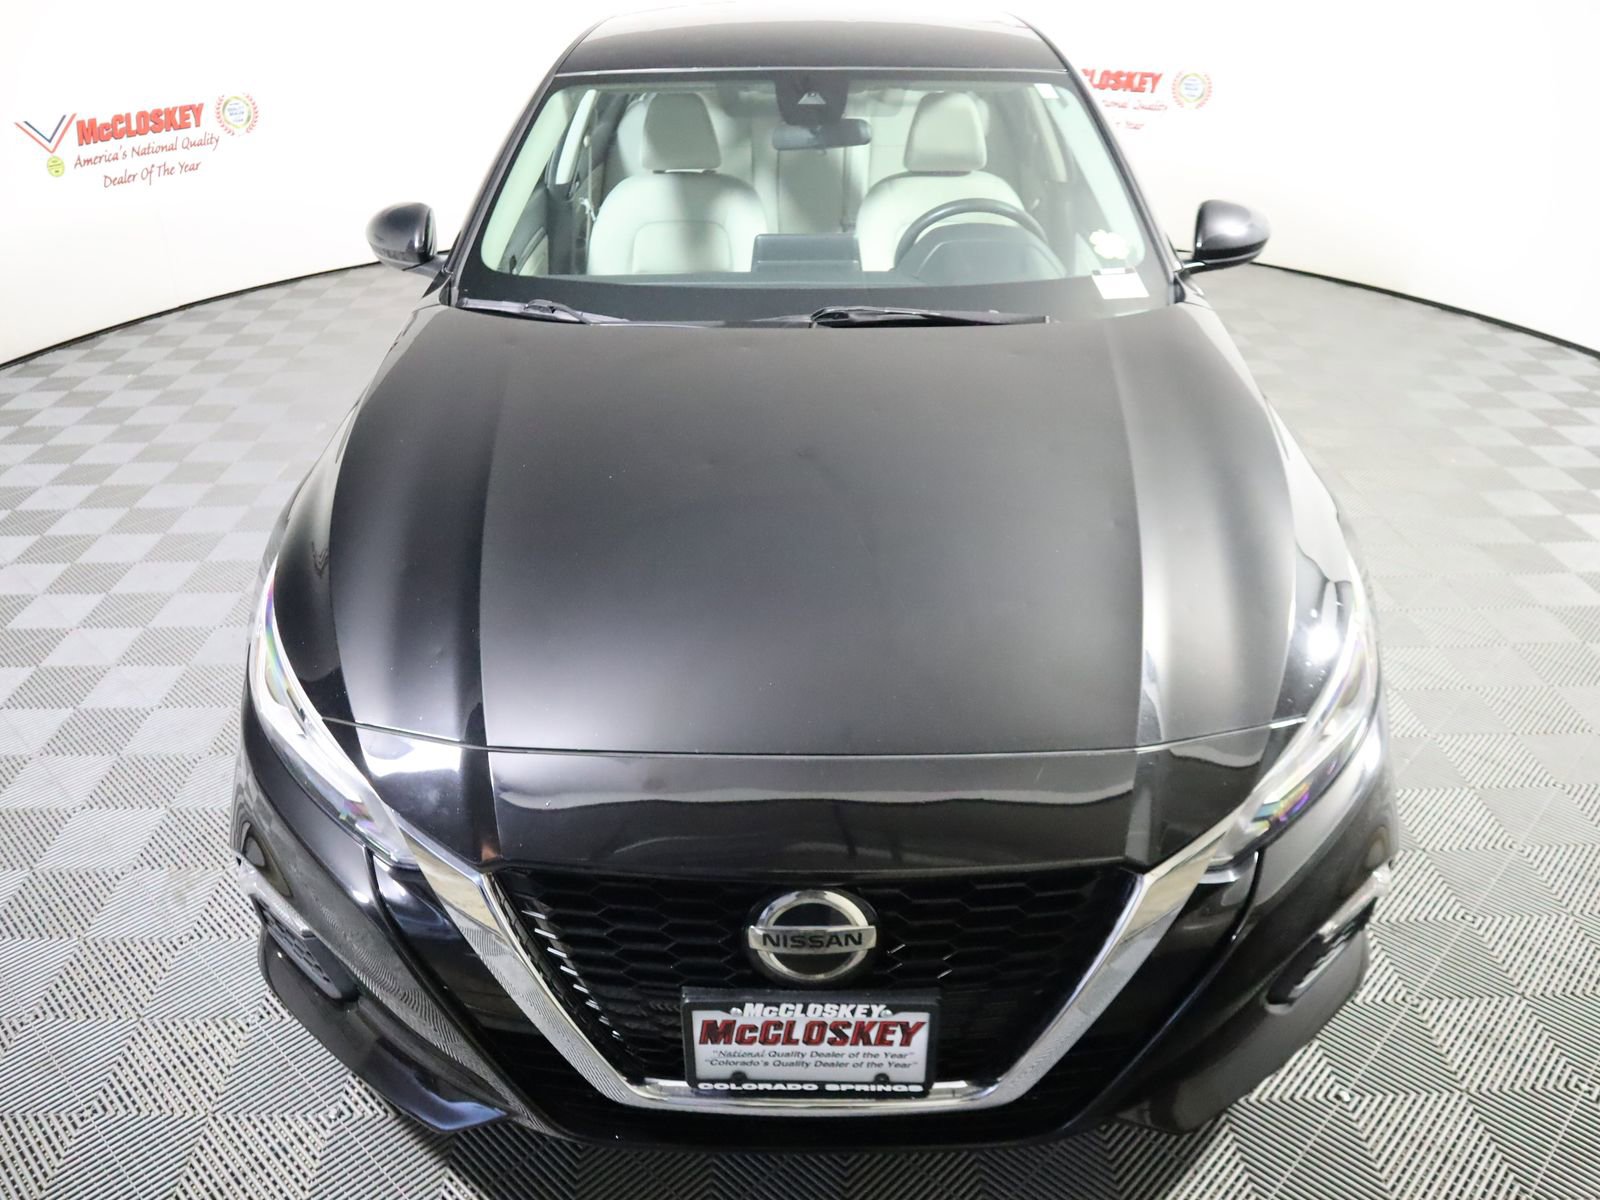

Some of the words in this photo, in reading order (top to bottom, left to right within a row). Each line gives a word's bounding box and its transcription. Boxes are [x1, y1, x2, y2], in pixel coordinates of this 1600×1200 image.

[76, 103, 204, 146] McCLOSKEY
[74, 145, 128, 168] America's
[131, 136, 178, 158] National
[181, 131, 220, 151] Quality
[103, 169, 138, 188] Dealer
[140, 164, 155, 186] Of
[157, 162, 176, 177] The
[178, 161, 201, 175] Year
[762, 932, 863, 949] NISSAN
[743, 1003, 887, 1018] McCLOSKEY
[699, 1020, 927, 1047] McCLOSKEY
[768, 1050, 808, 1059] Quality
[810, 1050, 845, 1059] Dealer
[848, 1051, 860, 1059] of
[862, 1051, 880, 1059] the
[772, 1059, 811, 1069] Quality
[814, 1060, 849, 1069] Dealer
[852, 1061, 864, 1069] of
[866, 1061, 884, 1069] the
[698, 1082, 819, 1092] COLORADO
[825, 1083, 924, 1093] SPRINGS
